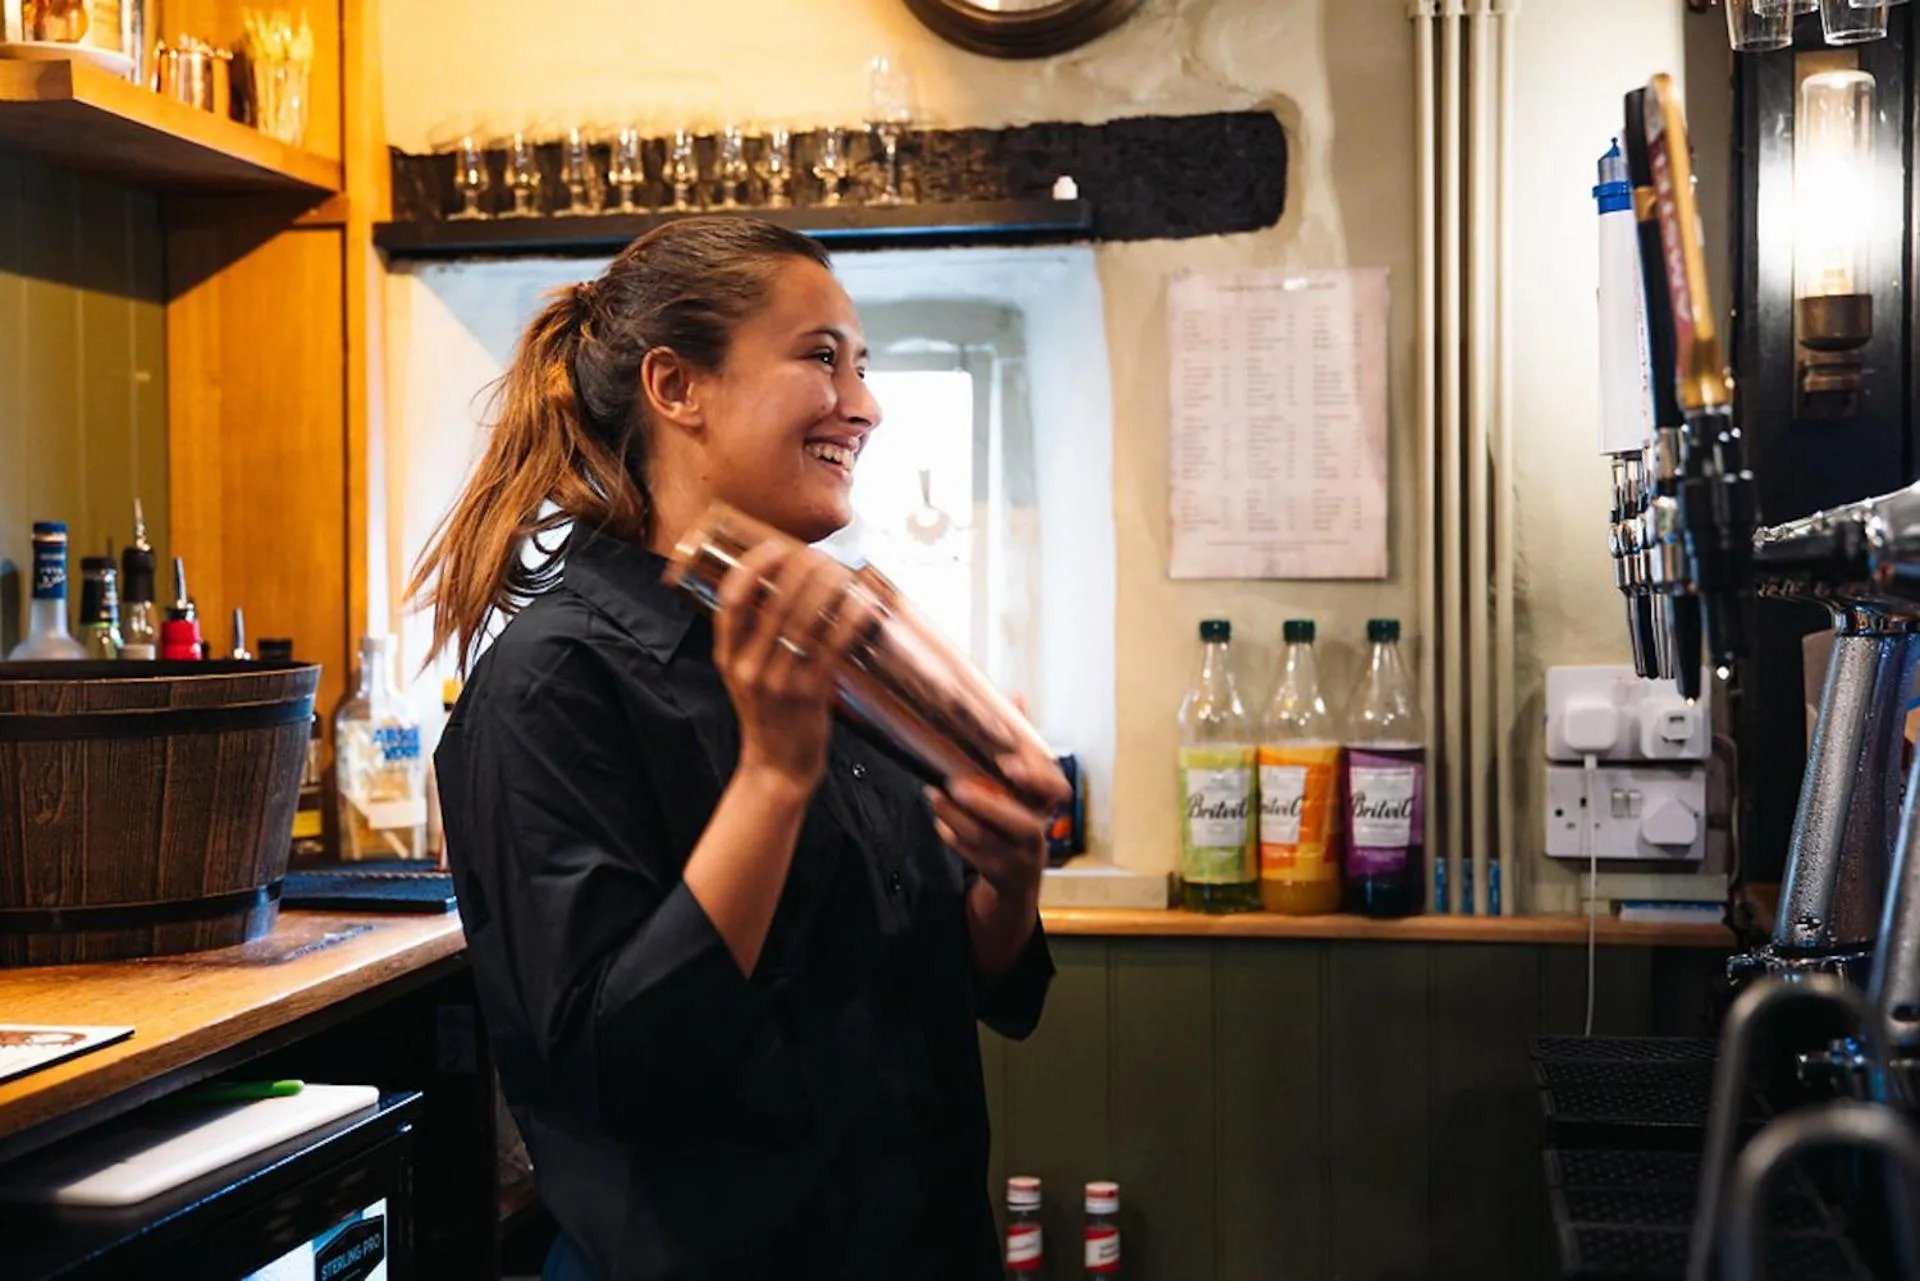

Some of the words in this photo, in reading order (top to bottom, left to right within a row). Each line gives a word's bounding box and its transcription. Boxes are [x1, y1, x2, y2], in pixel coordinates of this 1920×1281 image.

[1352, 790, 1416, 819] Britvic
[321, 1243, 362, 1281] STERLING
[363, 1232, 381, 1257] PRO
